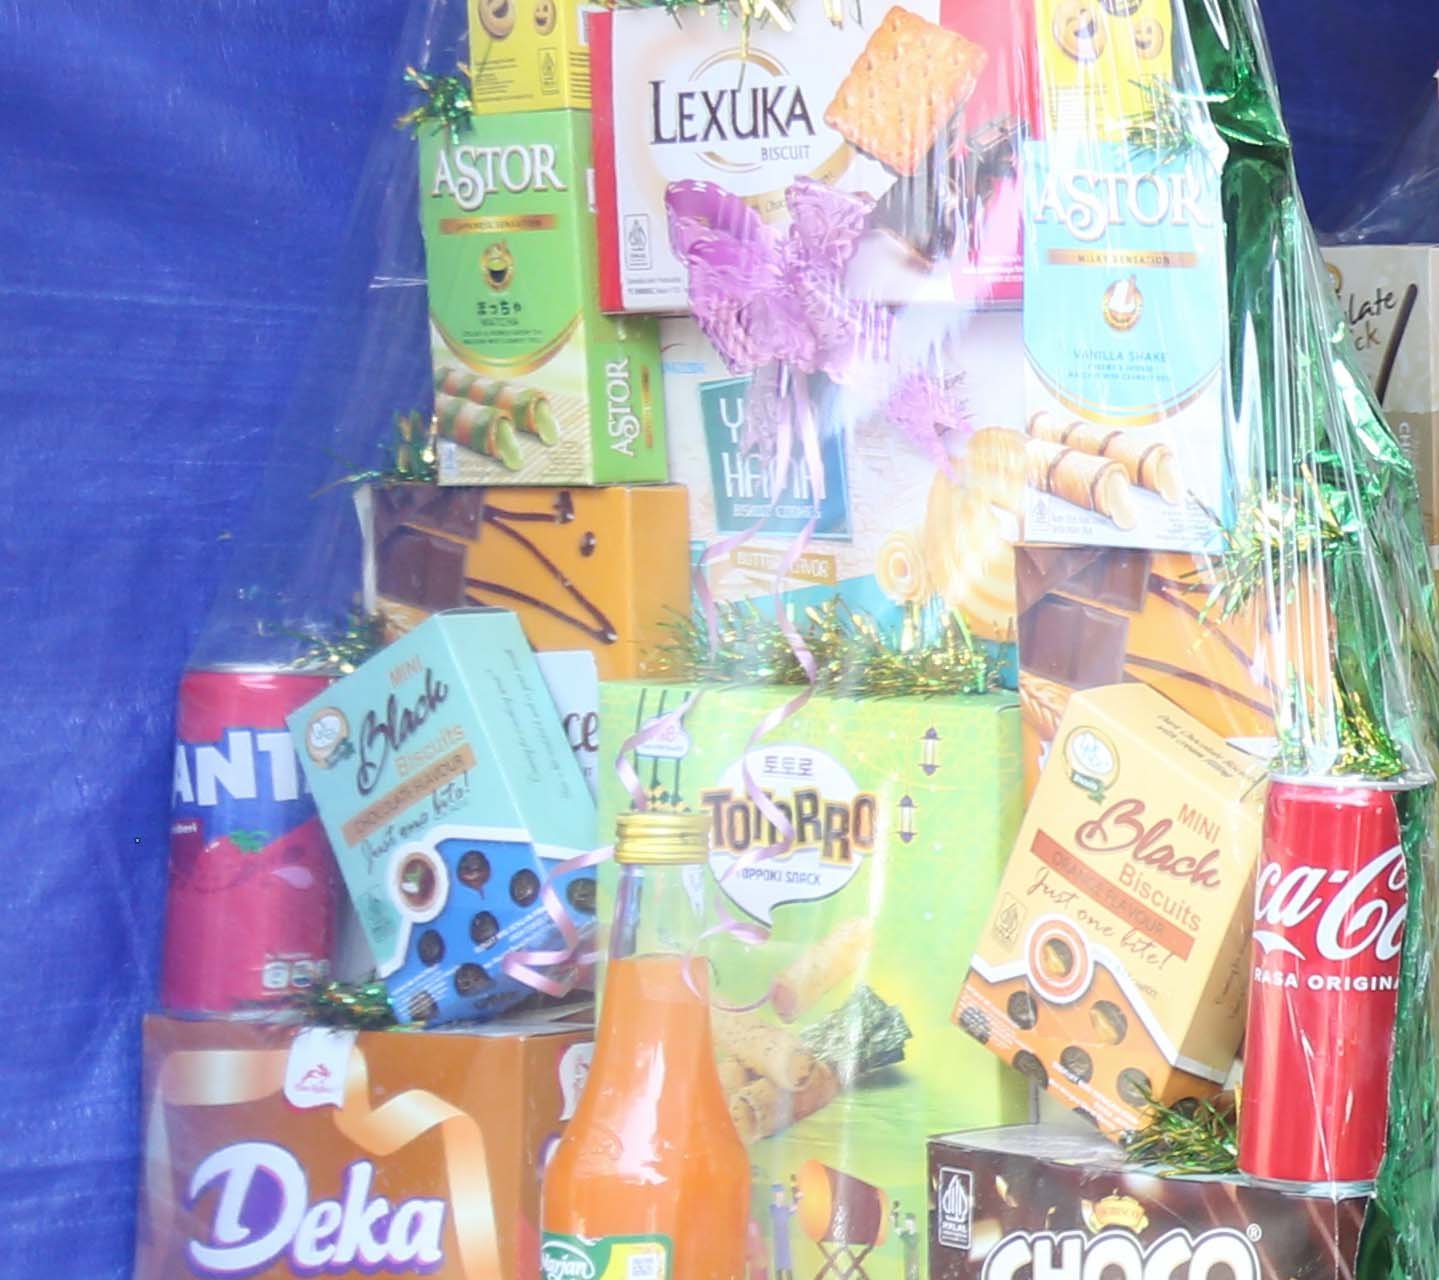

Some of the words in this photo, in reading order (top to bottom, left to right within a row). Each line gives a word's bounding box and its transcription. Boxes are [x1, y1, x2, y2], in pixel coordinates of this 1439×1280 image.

[649, 80, 816, 144] LEXUKA
[432, 144, 566, 211] ASTOR
[760, 145, 811, 161] BISCUIT
[1033, 174, 1213, 242] ASTOR
[606, 358, 640, 457] ASTOR
[357, 668, 449, 796] Black
[1075, 799, 1221, 889] Black
[1178, 803, 1220, 844] MINI
[1118, 862, 1201, 933] Biscuits
[187, 1140, 444, 1275] Deka
